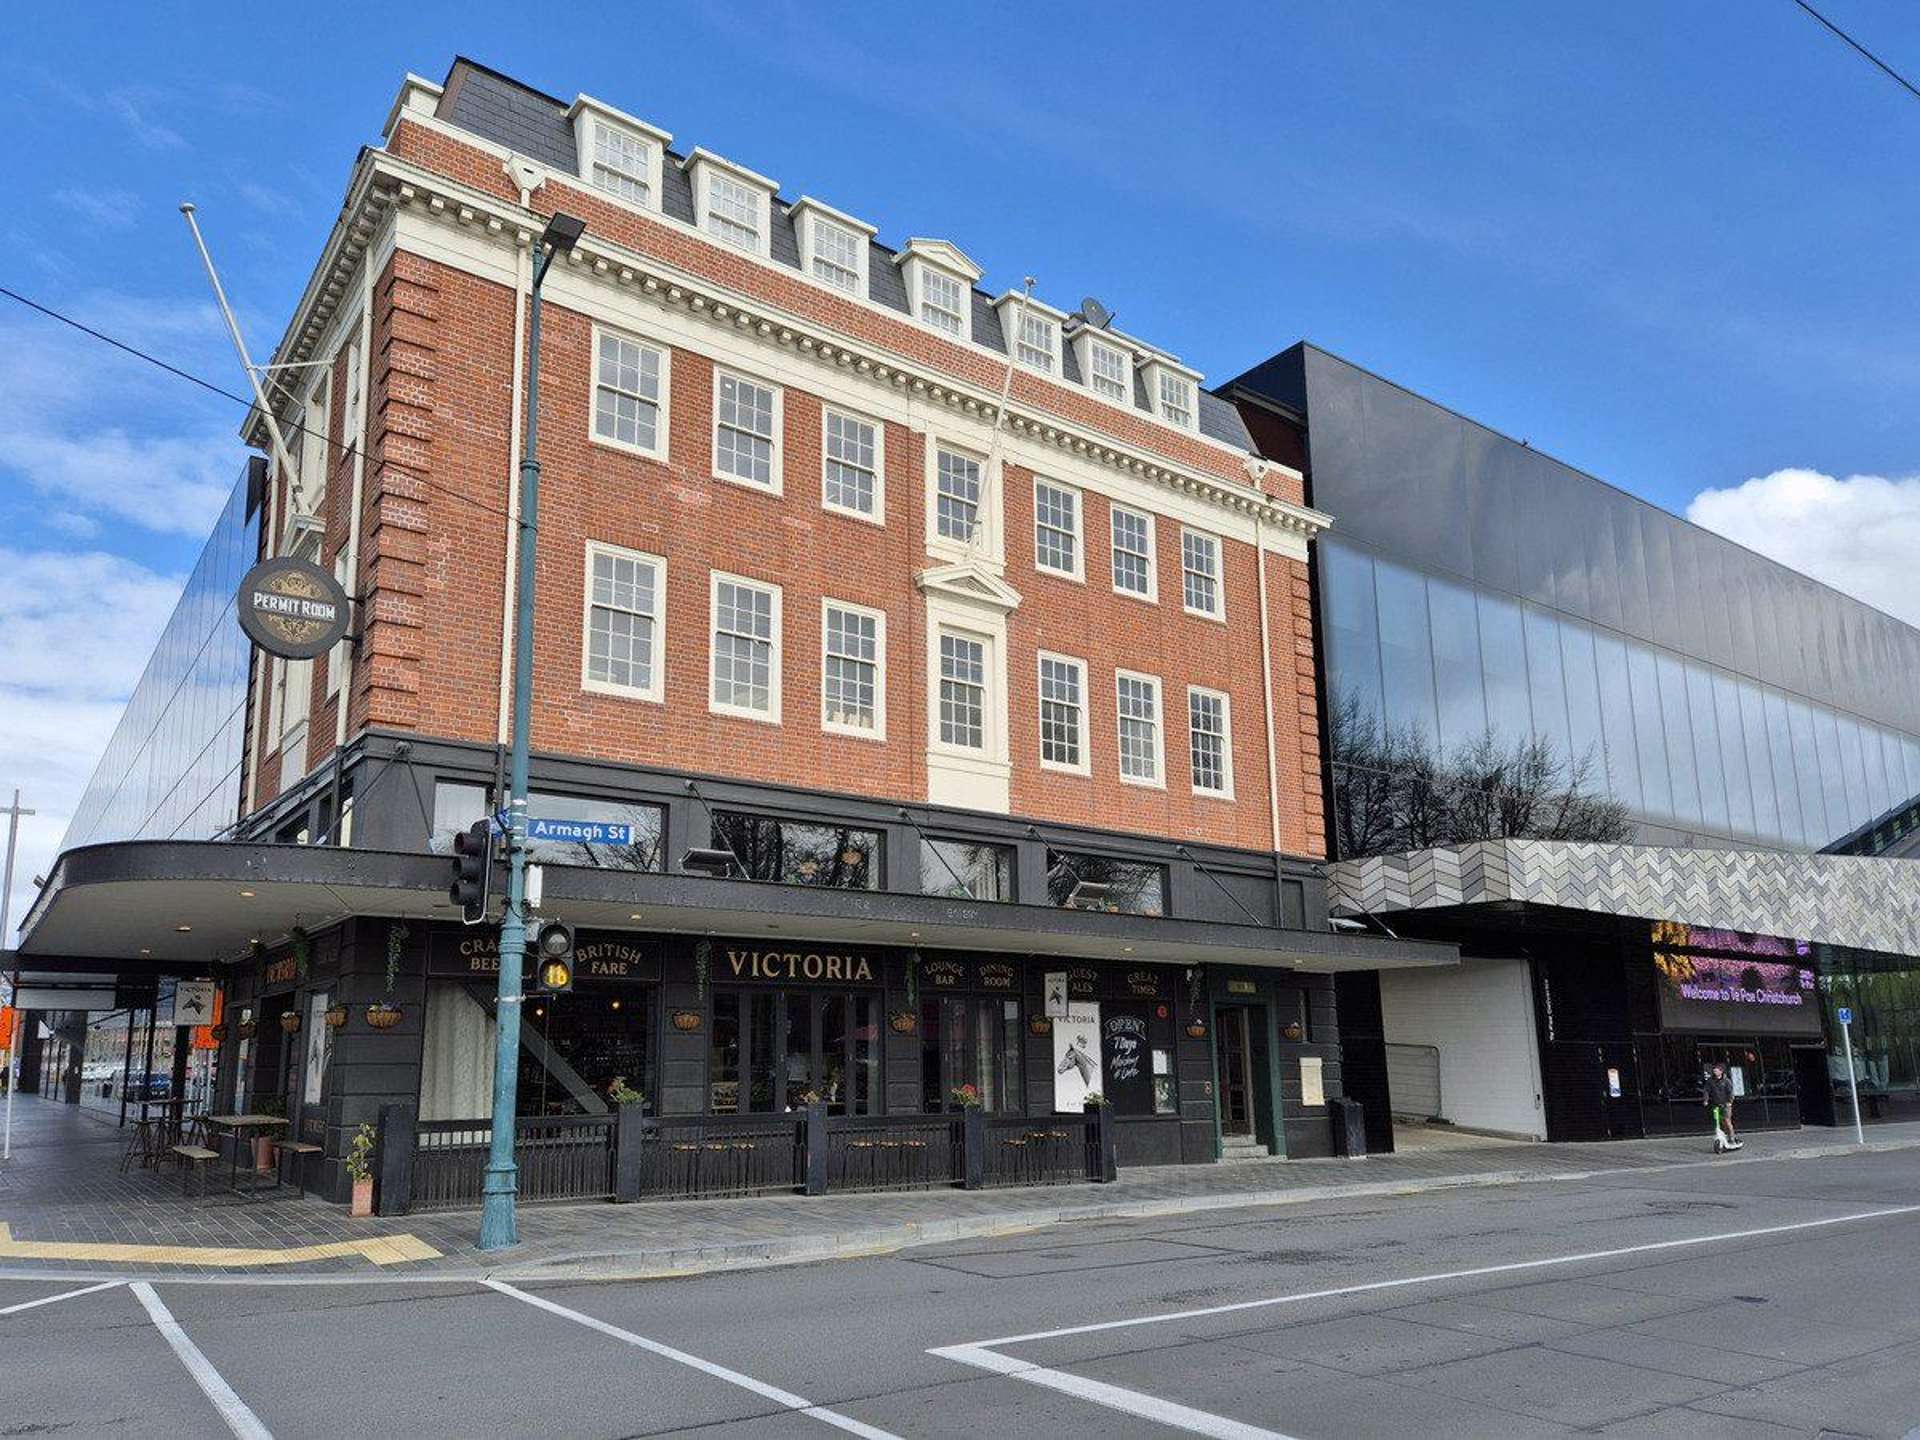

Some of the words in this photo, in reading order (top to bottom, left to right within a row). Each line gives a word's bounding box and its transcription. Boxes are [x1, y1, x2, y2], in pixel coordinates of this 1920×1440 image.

[253, 592, 299, 615] PERMIT
[301, 601, 336, 619] ROOM
[535, 822, 603, 841] Armagh
[608, 826, 626, 840] St
[576, 943, 642, 965] BRITISH
[471, 957, 501, 971] BEE
[591, 961, 628, 975] FARE
[727, 951, 873, 980] VICTORIA
[924, 961, 965, 976] LOUNGE
[935, 975, 955, 985] BAR
[983, 977, 1010, 987] ROOM
[1679, 983, 1721, 1001] Welcome
[1721, 991, 1730, 1001] to
[1730, 987, 1740, 1001] Te
[1740, 988, 1755, 1002] Pae
[1756, 988, 1802, 1005] Christchurch
[1109, 1018, 1142, 1032] OPEN
